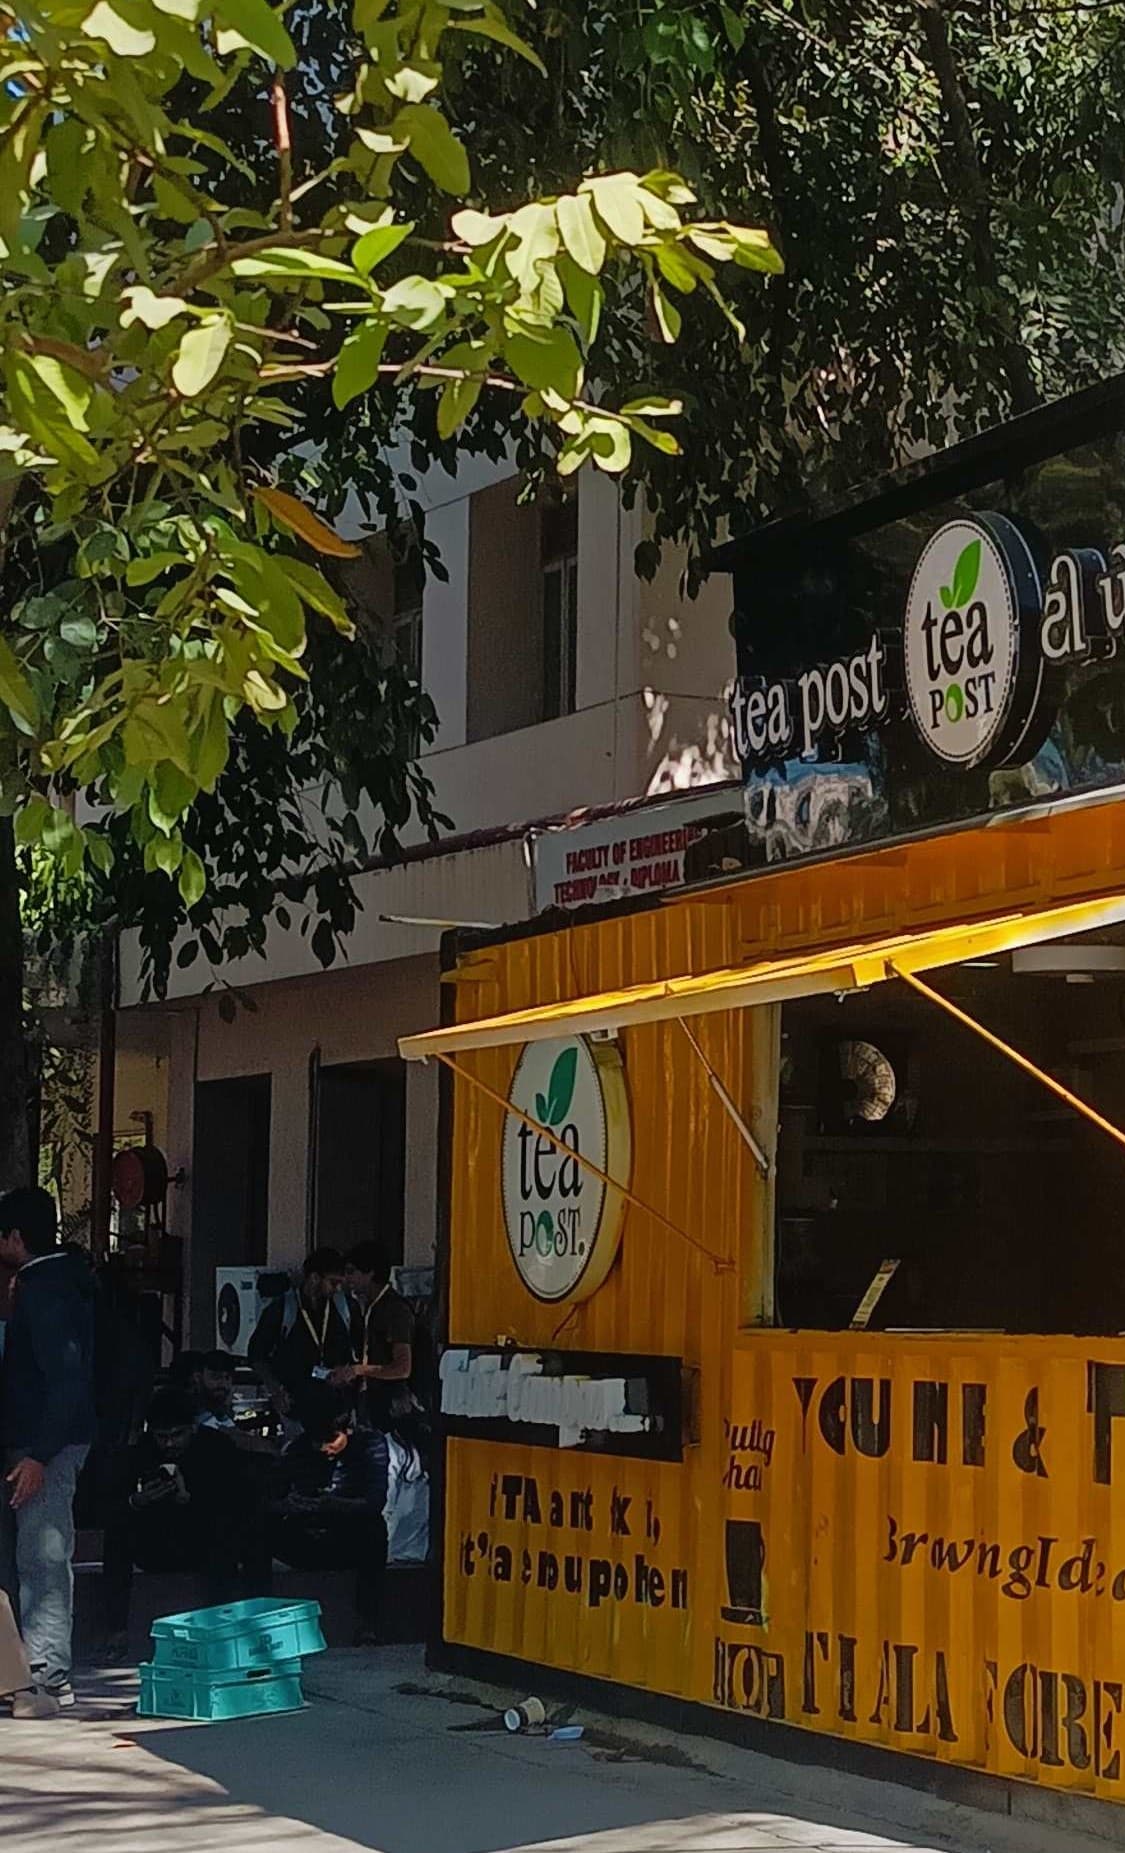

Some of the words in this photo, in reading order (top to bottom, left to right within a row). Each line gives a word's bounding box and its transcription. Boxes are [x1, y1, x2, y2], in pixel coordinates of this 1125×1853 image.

[921, 601, 994, 682] tea
[1041, 555, 1087, 659] ટી
[731, 681, 791, 759] tea
[799, 633, 886, 762] post
[566, 844, 611, 875] FACULTY
[612, 841, 627, 865] OF
[517, 1109, 585, 1200] tea
